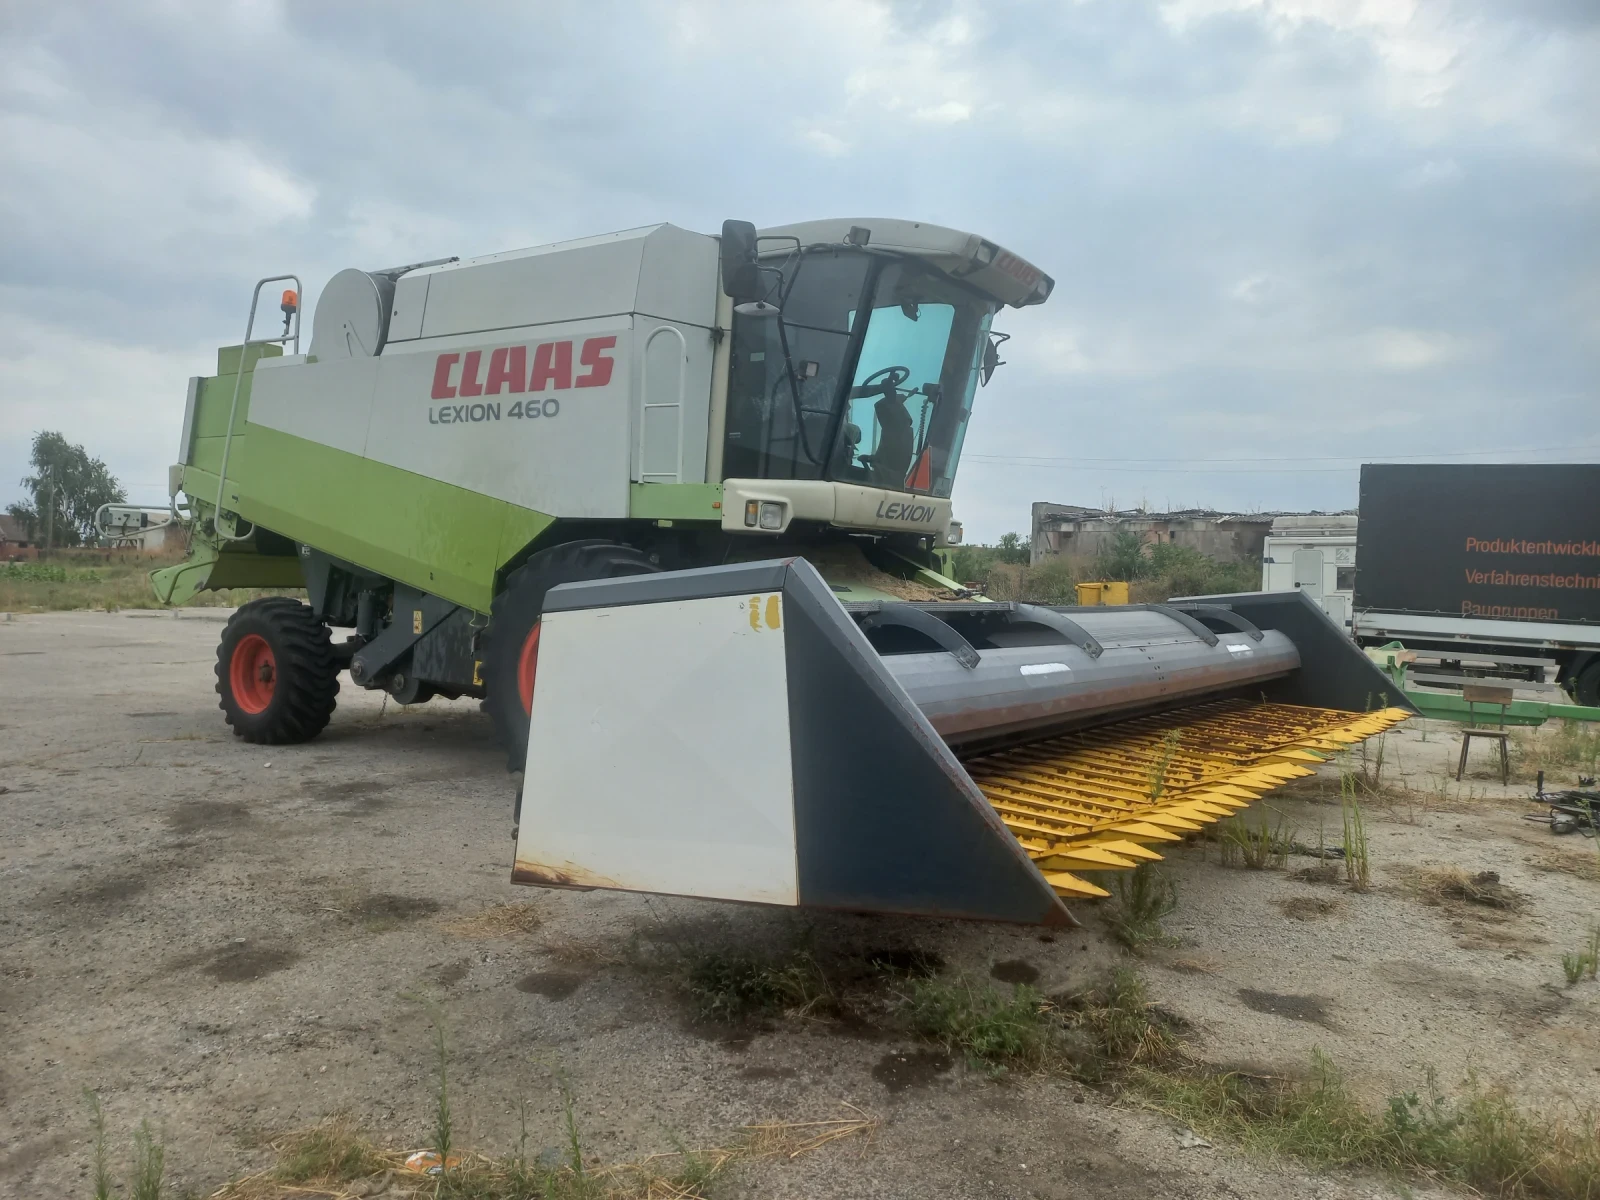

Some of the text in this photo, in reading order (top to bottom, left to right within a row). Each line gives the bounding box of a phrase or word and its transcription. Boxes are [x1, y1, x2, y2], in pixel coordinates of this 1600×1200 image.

[430, 336, 617, 399] CLAAS
[428, 398, 560, 424] LEXION 460
[876, 500, 936, 523] LEXION
[1461, 600, 1559, 621] Baugruppen
